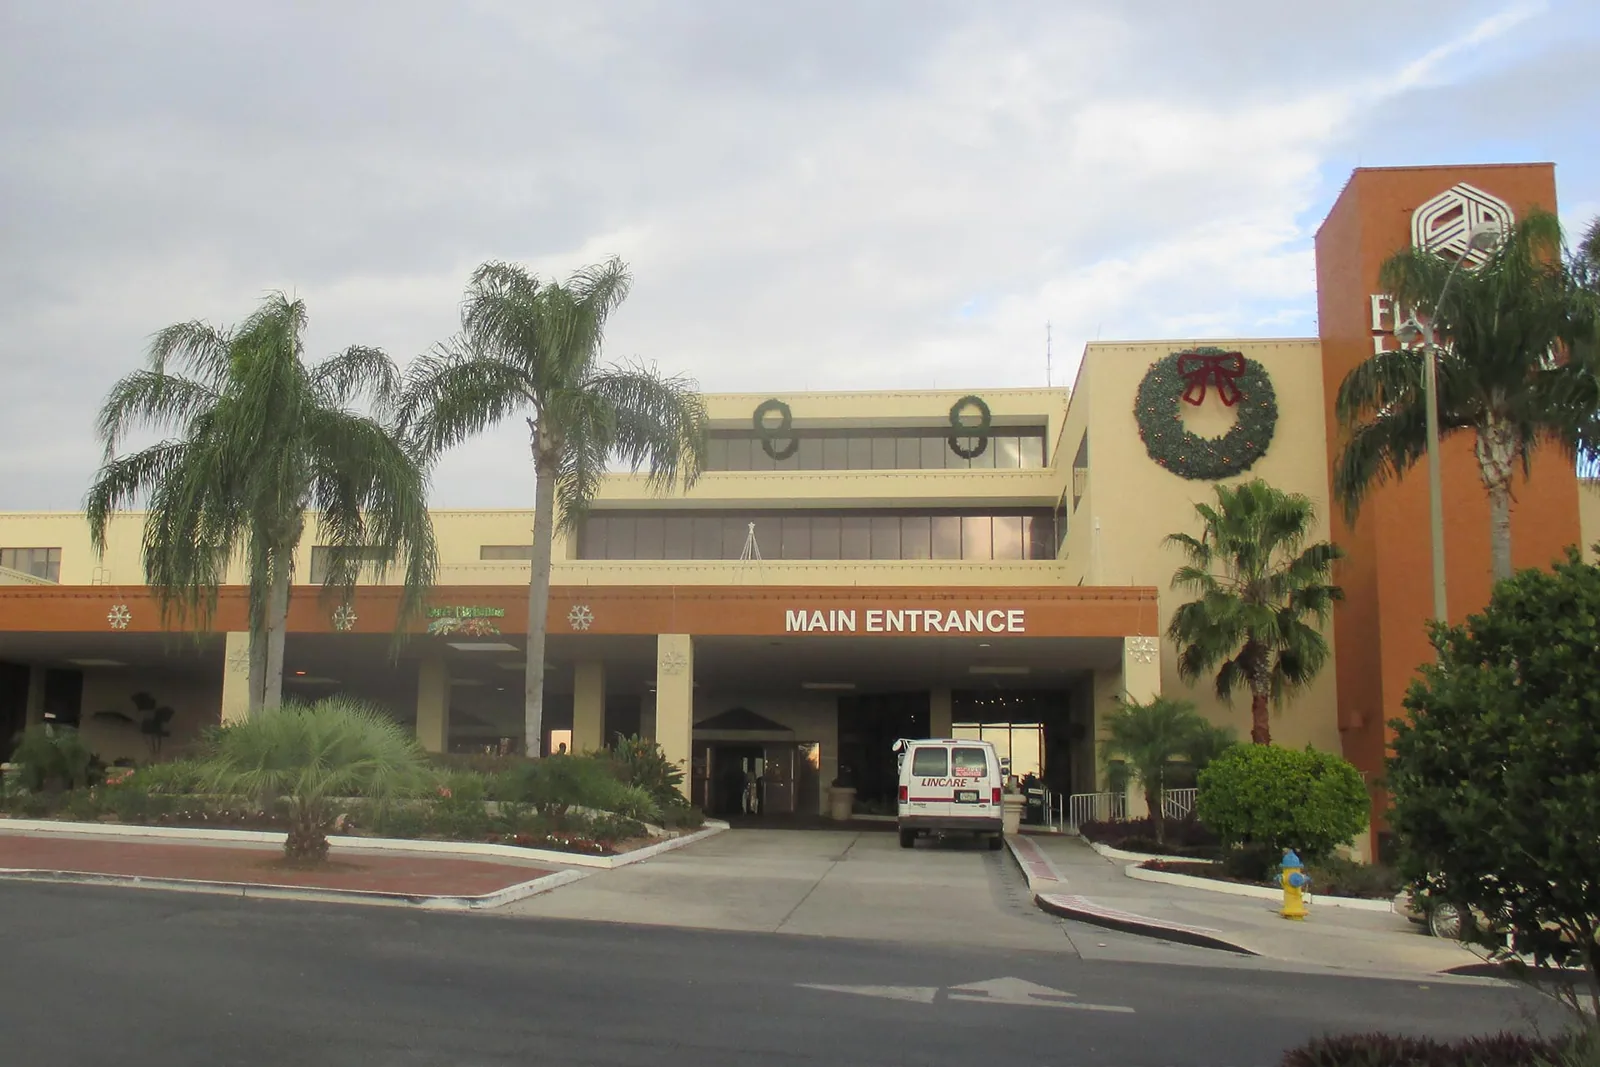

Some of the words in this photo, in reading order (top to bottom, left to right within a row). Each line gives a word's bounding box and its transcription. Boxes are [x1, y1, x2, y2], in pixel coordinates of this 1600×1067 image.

[785, 610, 856, 632] MAIN
[866, 610, 1025, 632] ENTRANCE
[921, 778, 968, 787] LINCARE
